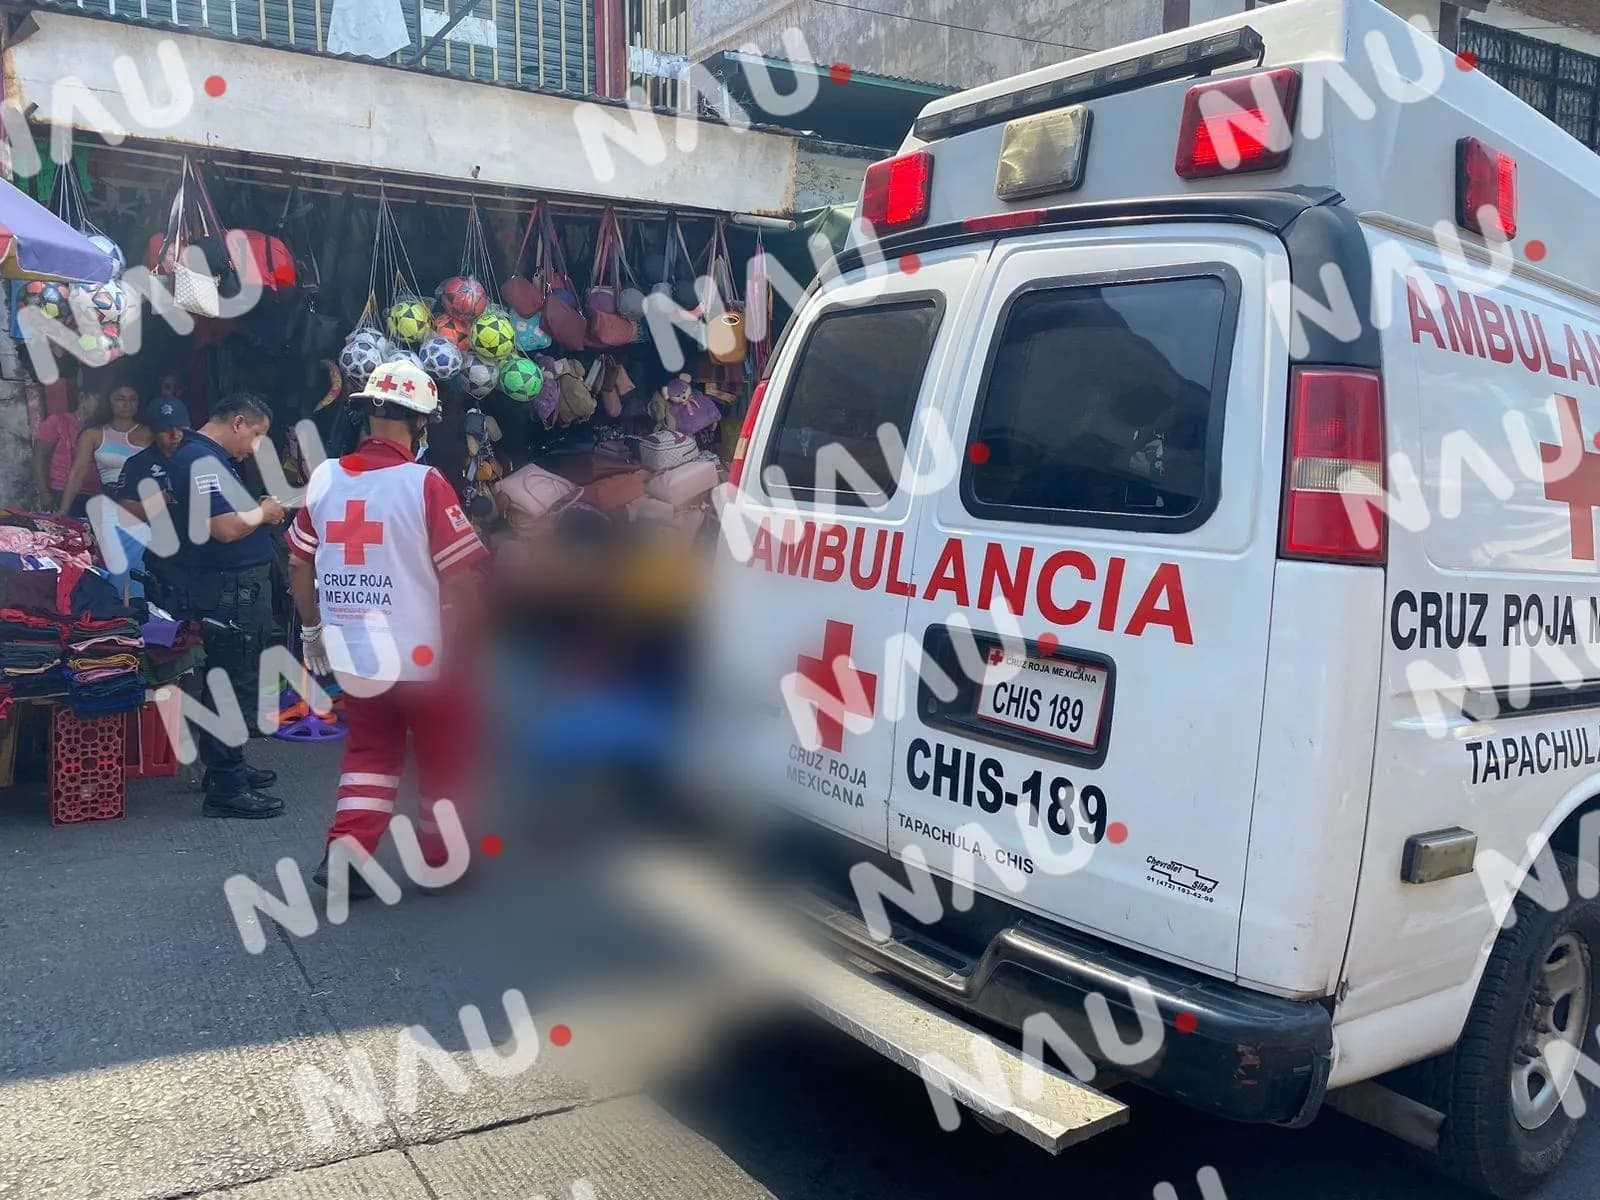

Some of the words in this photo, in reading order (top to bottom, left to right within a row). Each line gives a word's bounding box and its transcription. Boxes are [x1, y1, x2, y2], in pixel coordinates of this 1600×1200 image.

[324, 573, 356, 587] CRUZ
[360, 574, 393, 588] ROJA
[748, 514, 1194, 645] AMBULANCIA
[325, 590, 392, 606] MEXICANA
[1391, 590, 1489, 650] CRUZ
[1503, 594, 1576, 646] ROJA
[1006, 656, 1027, 669] CRUZ
[1028, 661, 1050, 673] ROJA
[1051, 667, 1097, 684] MEXICANA
[992, 681, 1042, 723] CHIS
[1049, 693, 1083, 733] 189
[788, 743, 824, 771] CRUZ
[829, 758, 867, 788] ROJA
[786, 765, 864, 808] MEXICANA
[906, 737, 1107, 845] CHIS-189
[995, 848, 1034, 875] CHIS
[1146, 855, 1182, 874] Chevrolet
[1192, 880, 1213, 894] Silao
